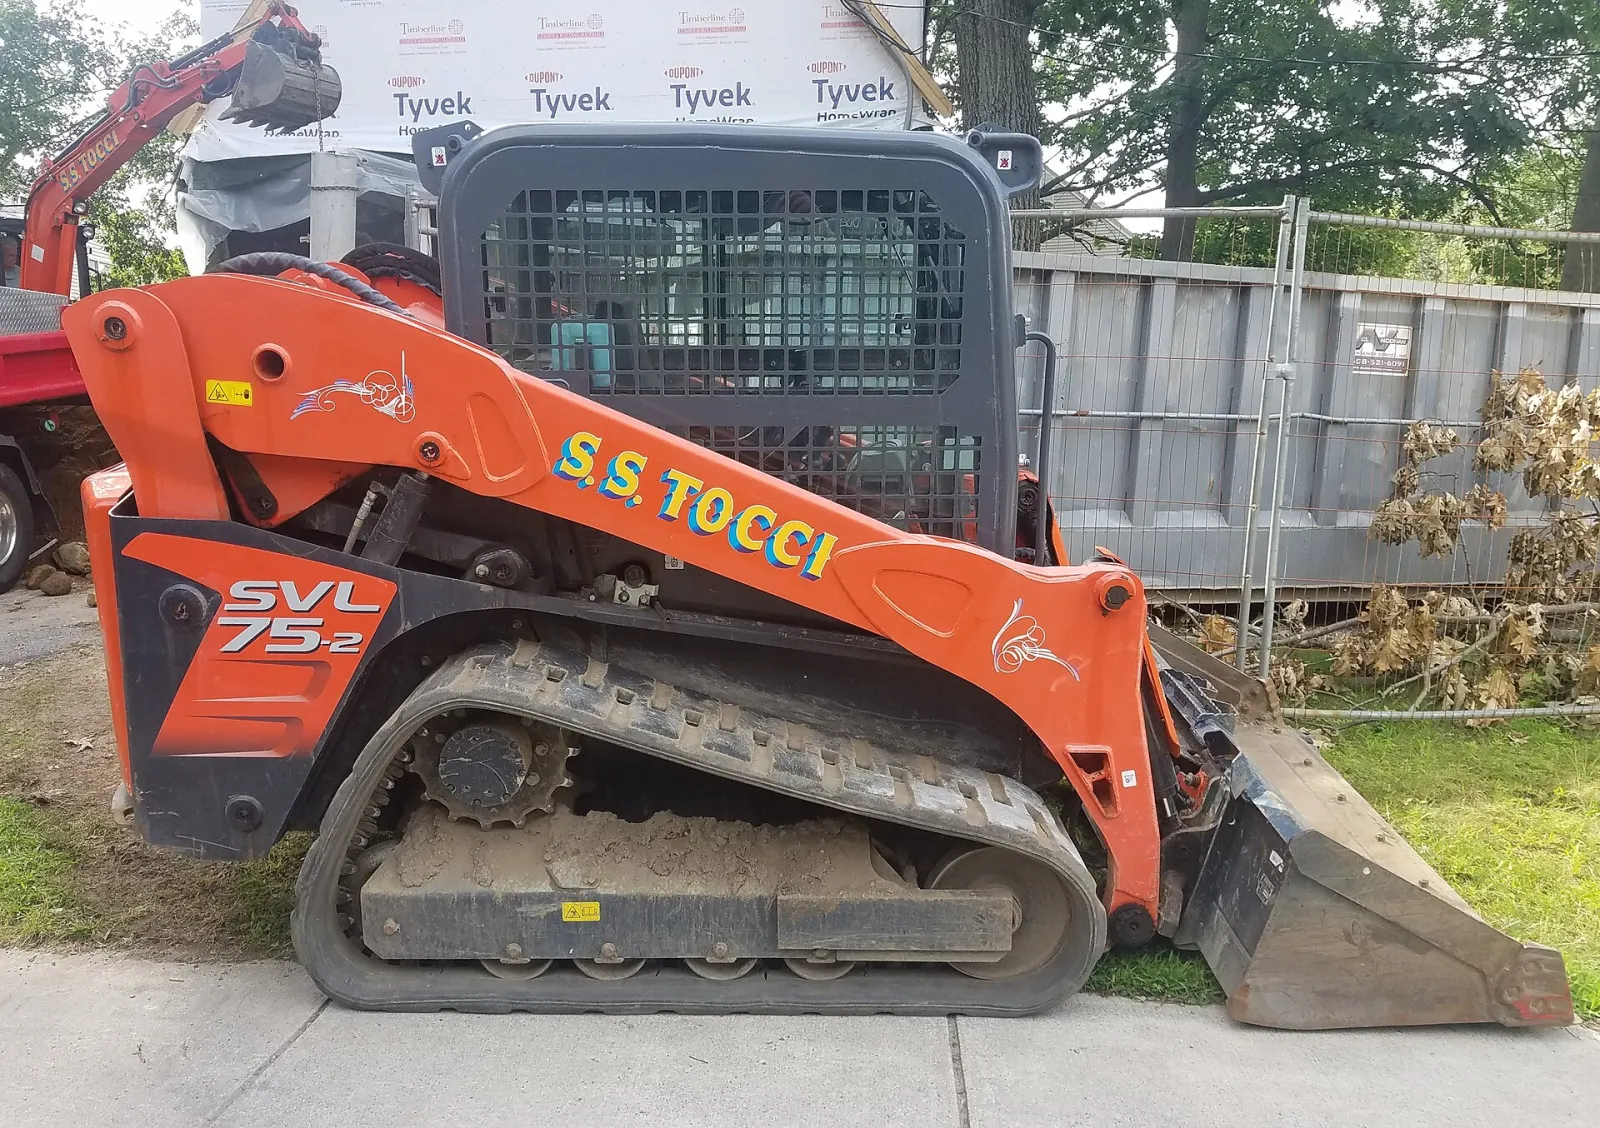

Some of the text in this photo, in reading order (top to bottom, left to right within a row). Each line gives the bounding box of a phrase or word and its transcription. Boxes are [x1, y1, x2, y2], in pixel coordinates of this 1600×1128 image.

[400, 22, 446, 35] Timberline
[538, 17, 584, 29] Timberline
[679, 11, 726, 25] Timberline
[391, 76, 421, 88] DUPONT
[529, 72, 559, 83] DUPONT
[668, 66, 700, 79] DUPONT
[811, 62, 842, 73] DUPONT
[393, 91, 473, 123] Tyvek
[530, 86, 611, 119] Tyvek
[670, 81, 752, 114] Tyvek
[812, 76, 895, 109] Tyvek
[78, 129, 120, 174] TOCCI
[552, 431, 838, 582] S.S. TOCCI
[223, 580, 381, 613] SVL
[217, 617, 364, 654] 75-2
